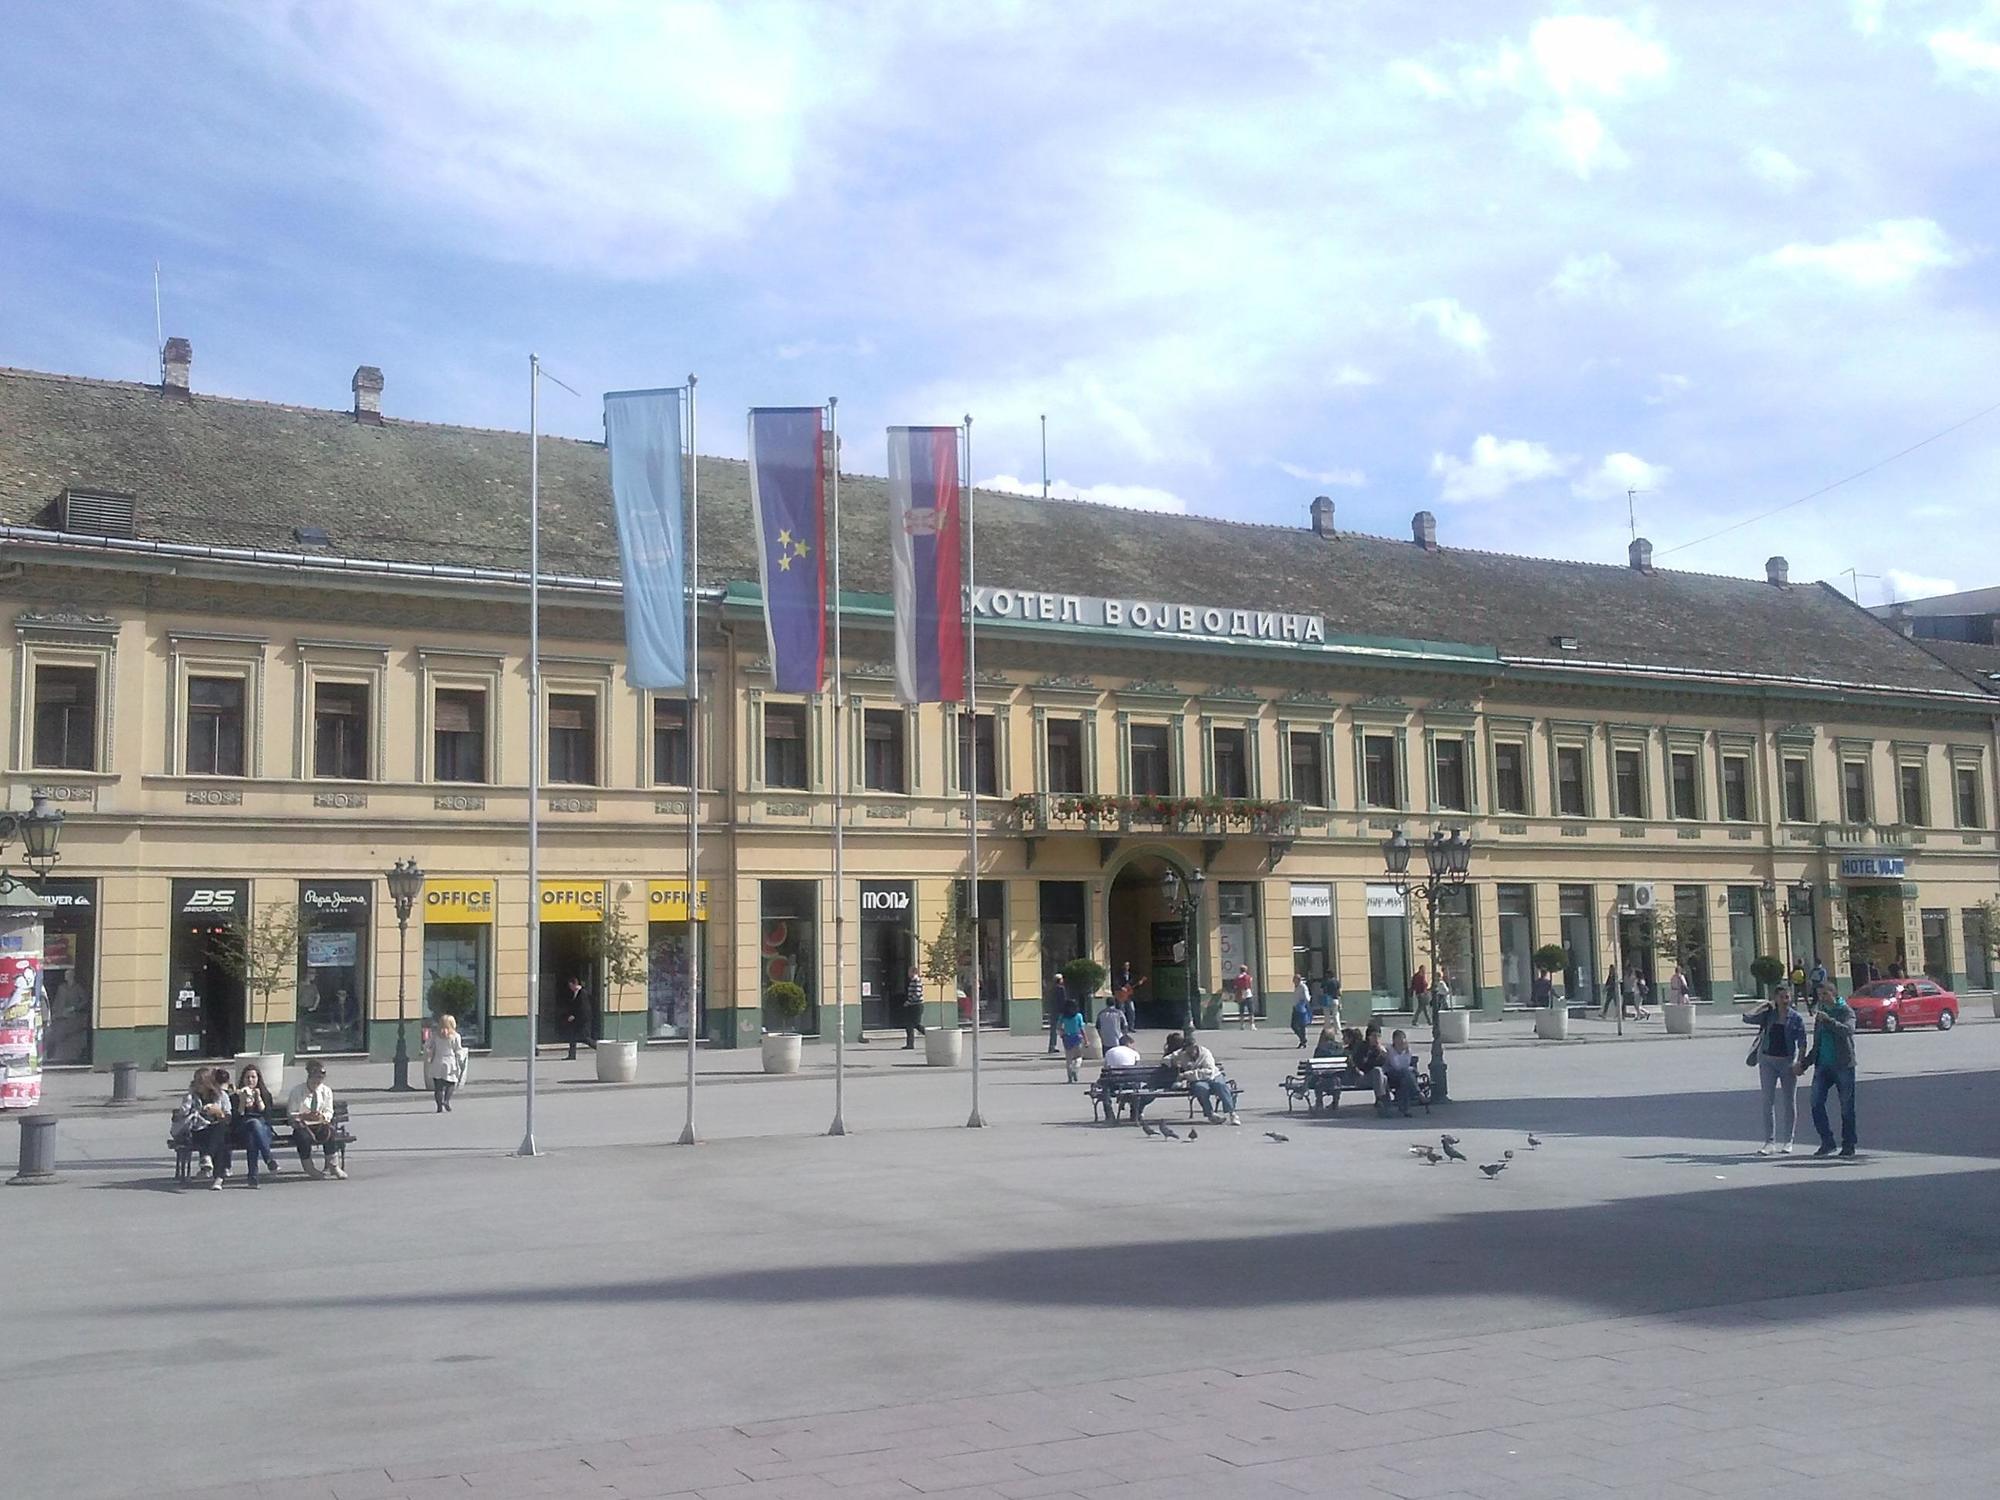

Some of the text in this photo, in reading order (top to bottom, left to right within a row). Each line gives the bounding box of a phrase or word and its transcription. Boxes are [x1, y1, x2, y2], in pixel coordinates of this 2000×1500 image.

[1105, 600, 1323, 641] ВОЈВОДИНА
[1842, 859, 1877, 874] HOTEL
[186, 890, 236, 905] BS
[427, 891, 491, 905] OFFICE
[541, 891, 602, 904] OFFICE
[651, 891, 707, 904] OFFIE
